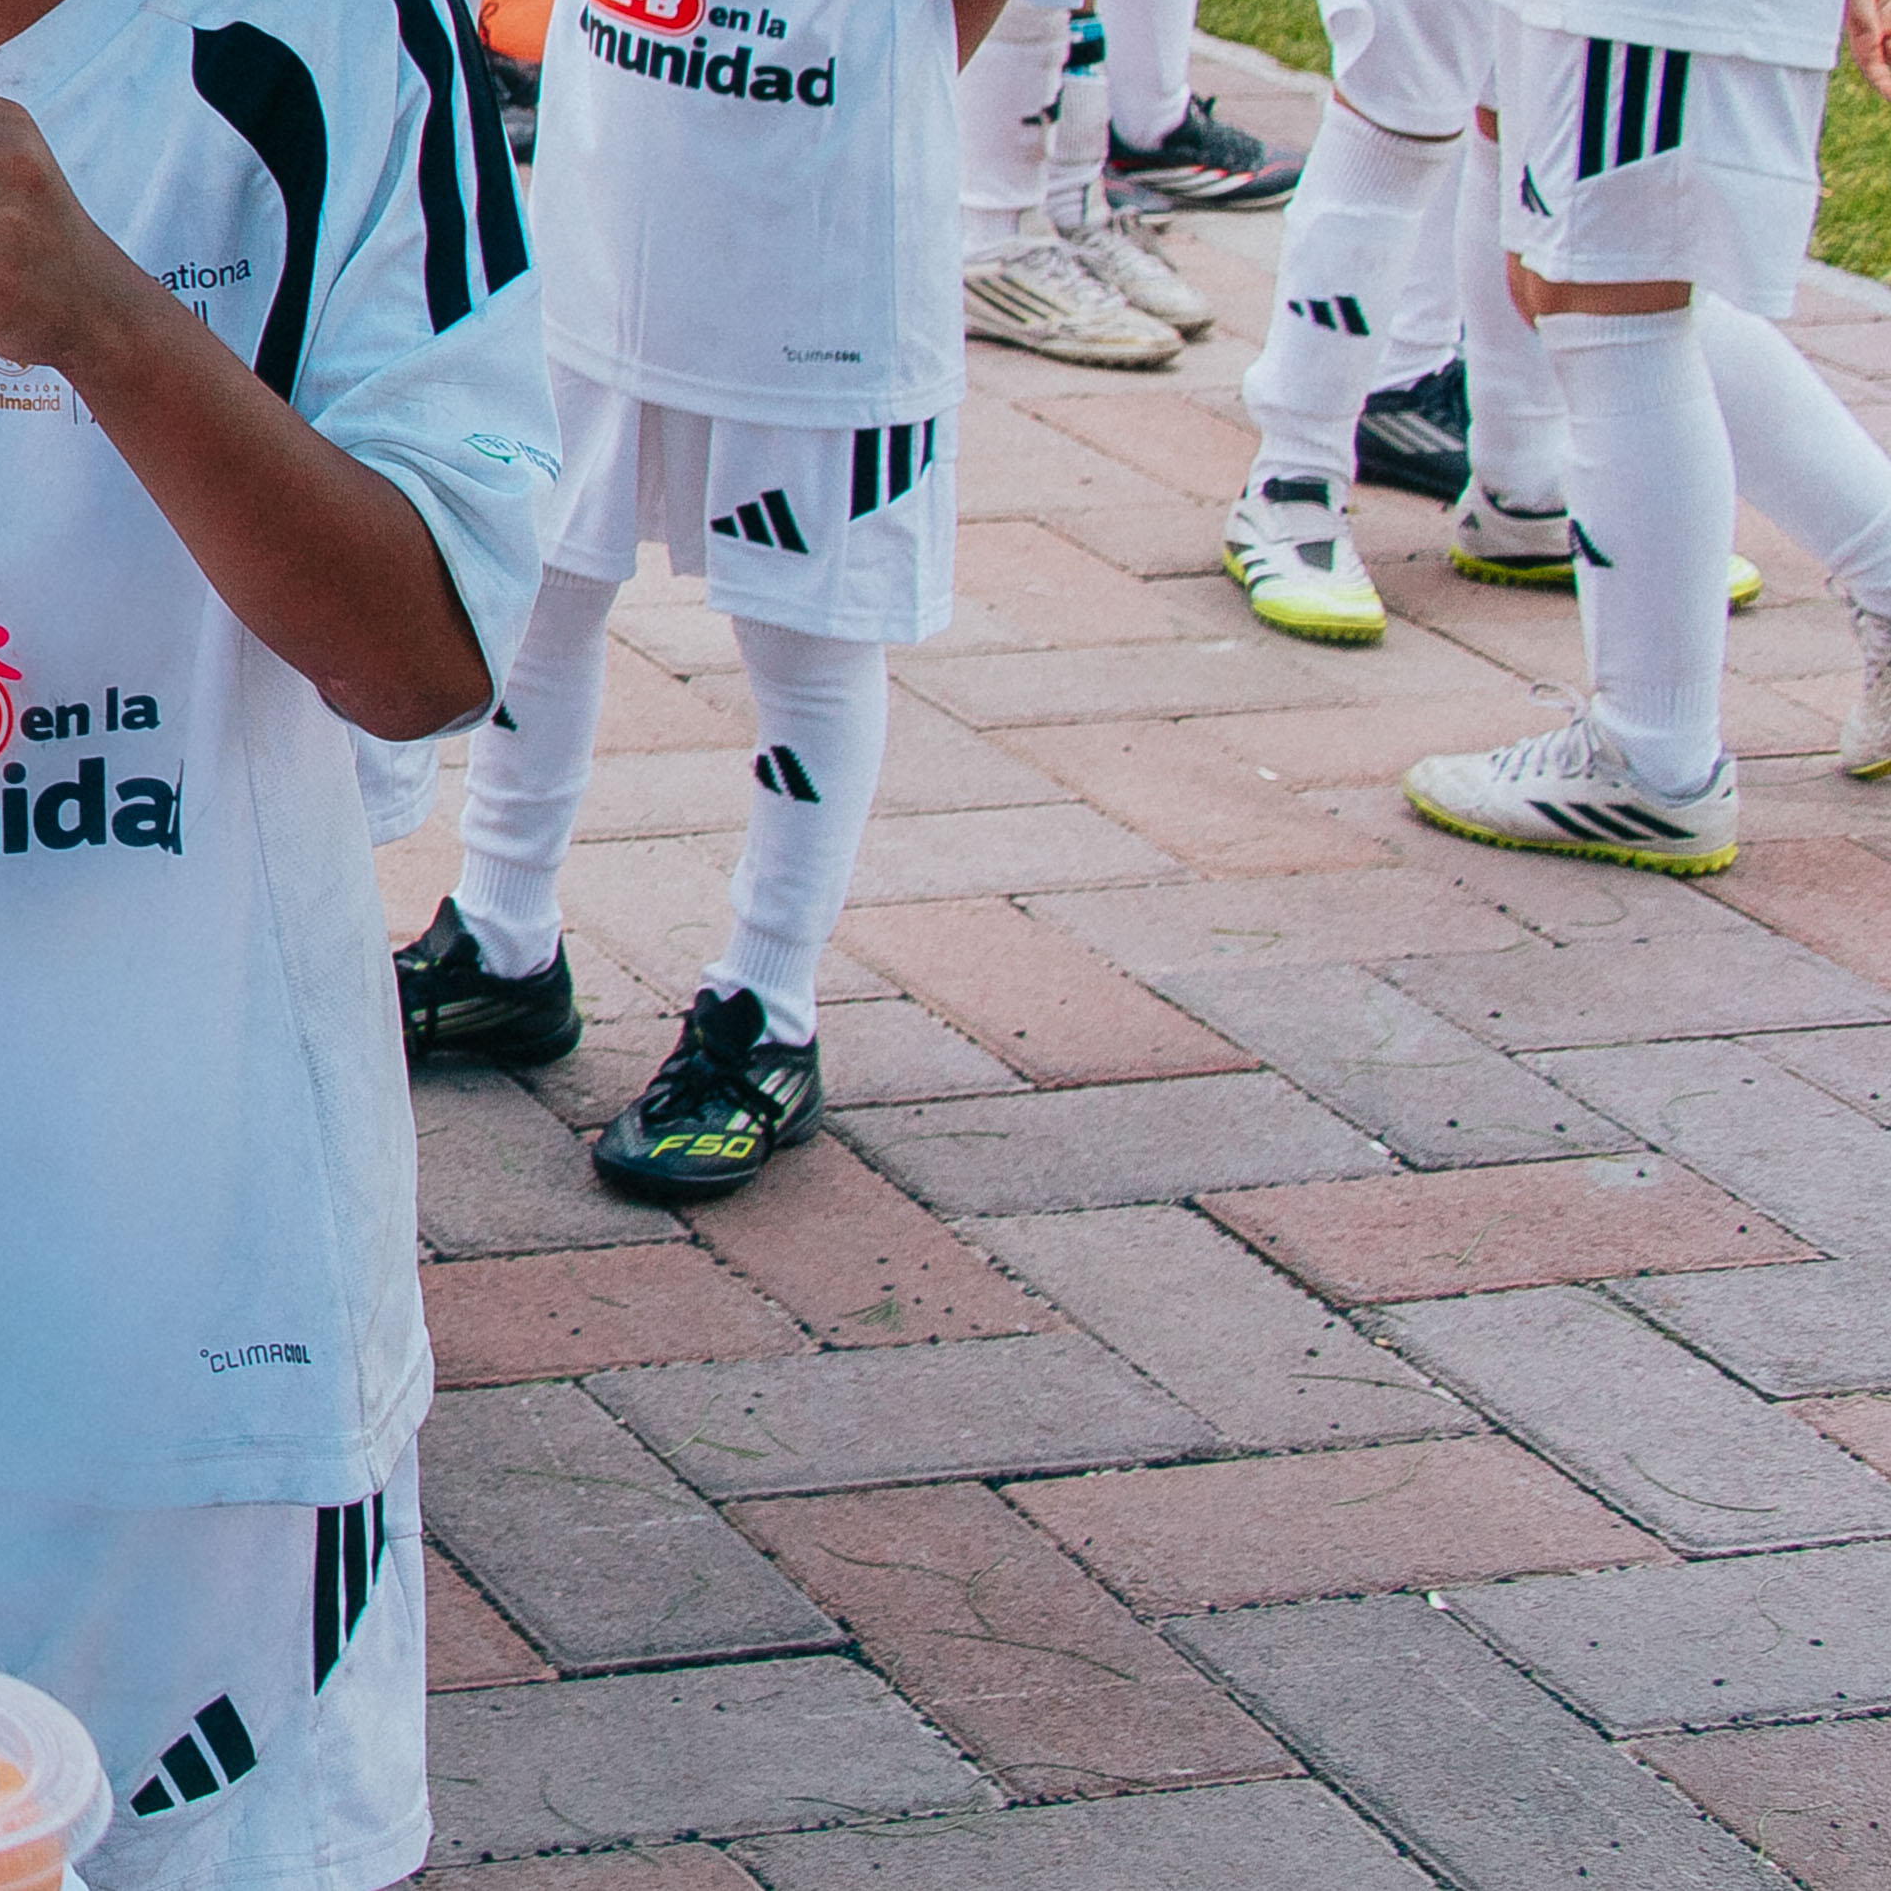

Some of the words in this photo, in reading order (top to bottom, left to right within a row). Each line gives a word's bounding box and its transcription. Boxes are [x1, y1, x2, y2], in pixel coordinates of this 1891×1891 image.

[708, 6, 752, 32] en
[757, 8, 787, 40] la
[18, 702, 91, 742] en
[104, 686, 162, 732] la
[648, 1133, 756, 1159] F50
